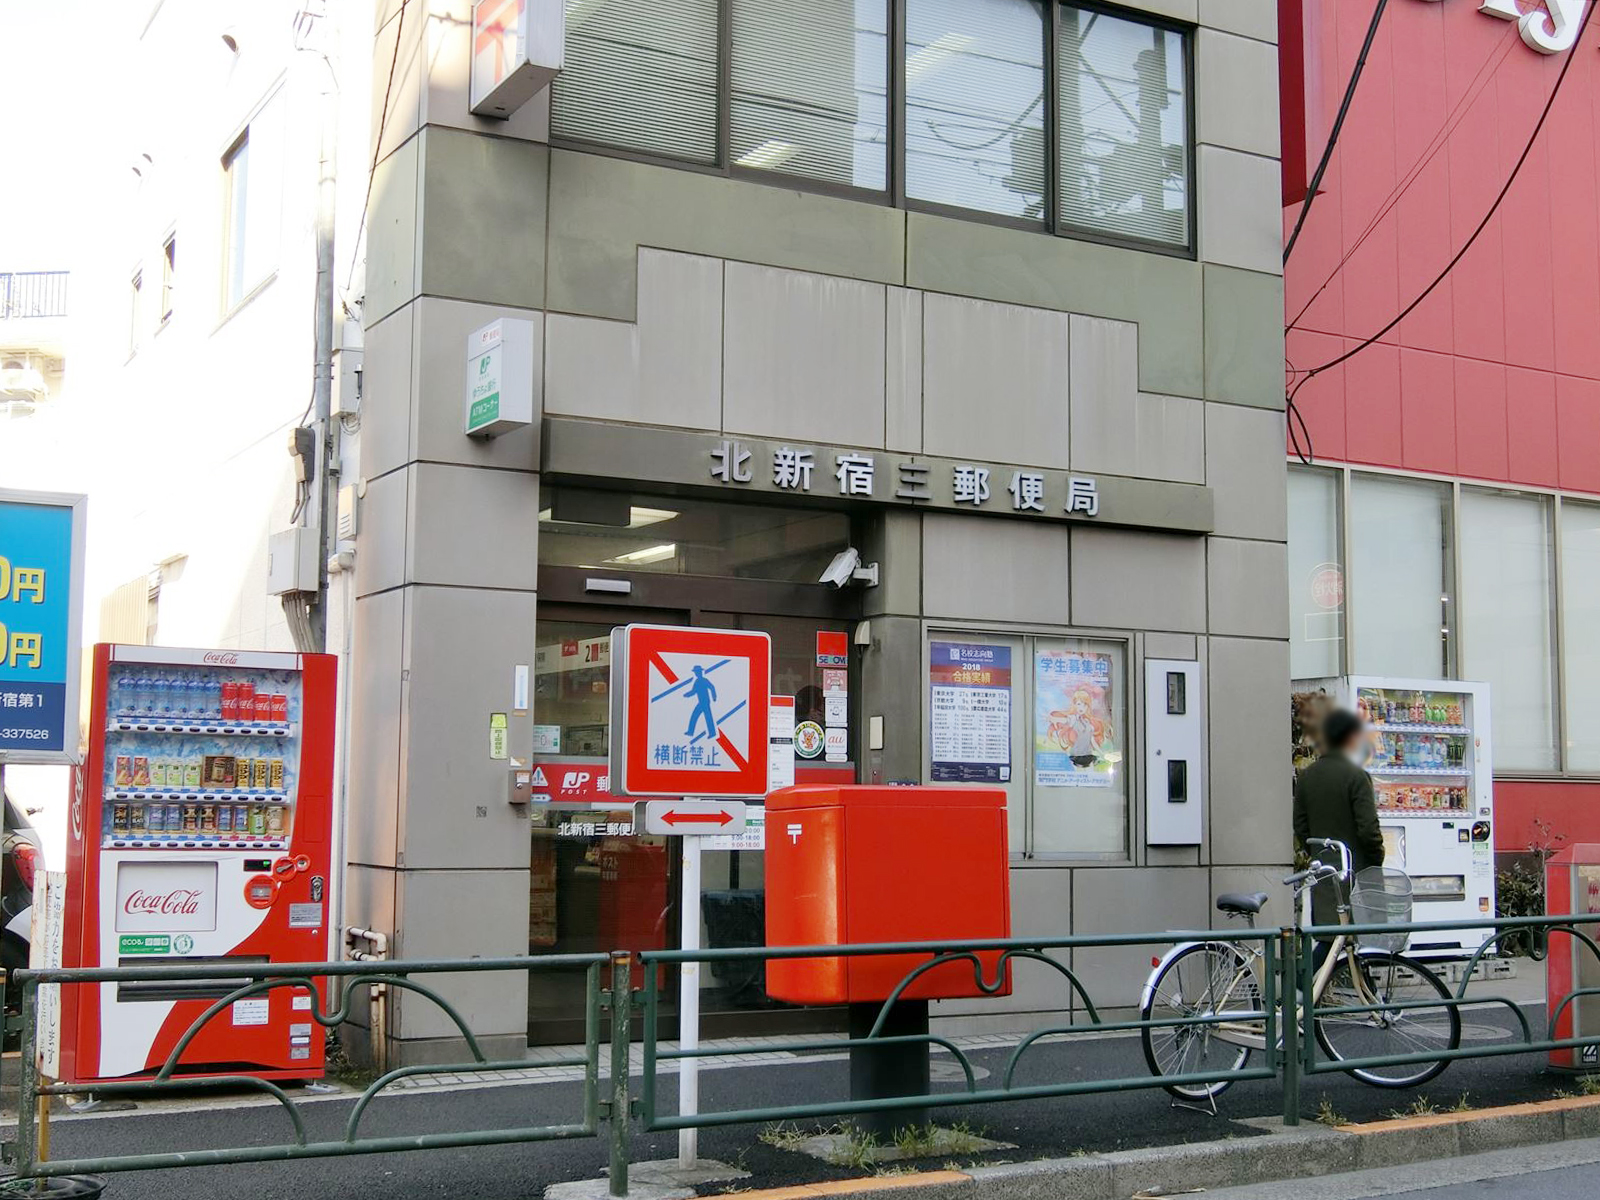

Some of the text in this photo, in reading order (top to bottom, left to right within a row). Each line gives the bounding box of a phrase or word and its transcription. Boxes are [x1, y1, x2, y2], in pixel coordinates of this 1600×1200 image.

[710, 440, 1100, 517] 北新宿三郵便局
[962, 662, 981, 671] 2018
[1041, 657, 1106, 674] 学生募集中
[952, 671, 991, 683] 合格実績
[0, 692, 43, 708] 宿第1
[654, 744, 721, 766] 横断禁止
[124, 889, 204, 914] Coca-Cola
